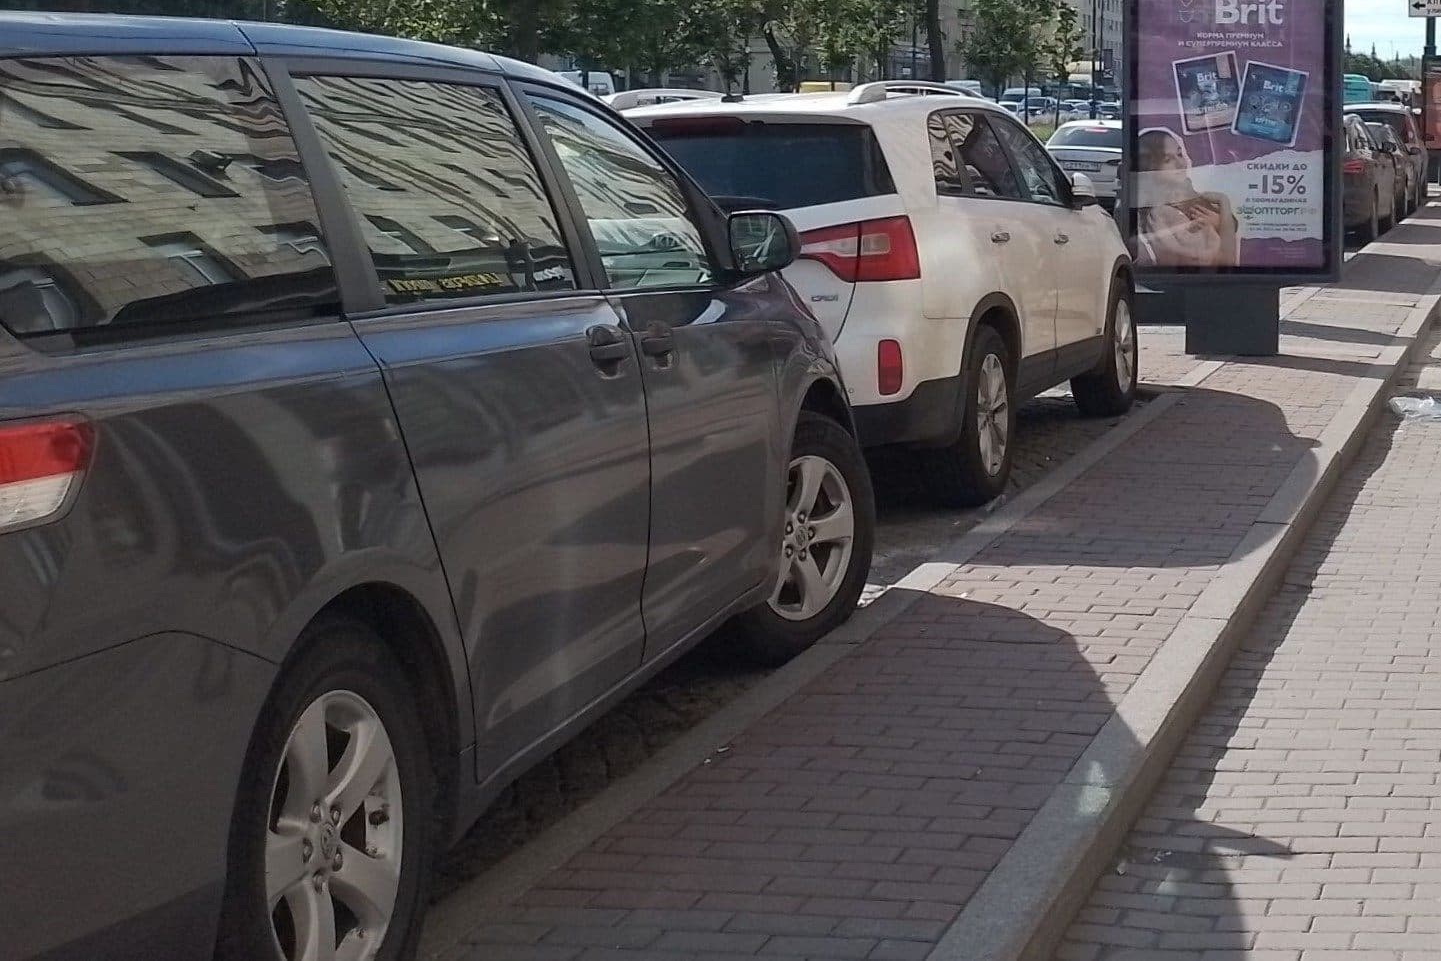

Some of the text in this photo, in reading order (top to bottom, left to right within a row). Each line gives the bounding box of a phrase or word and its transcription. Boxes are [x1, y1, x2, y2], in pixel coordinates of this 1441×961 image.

[1262, 80, 1285, 93] Brit
[1246, 163, 1308, 171] СКИДКИ ДО
[1248, 174, 1307, 195] -15%
